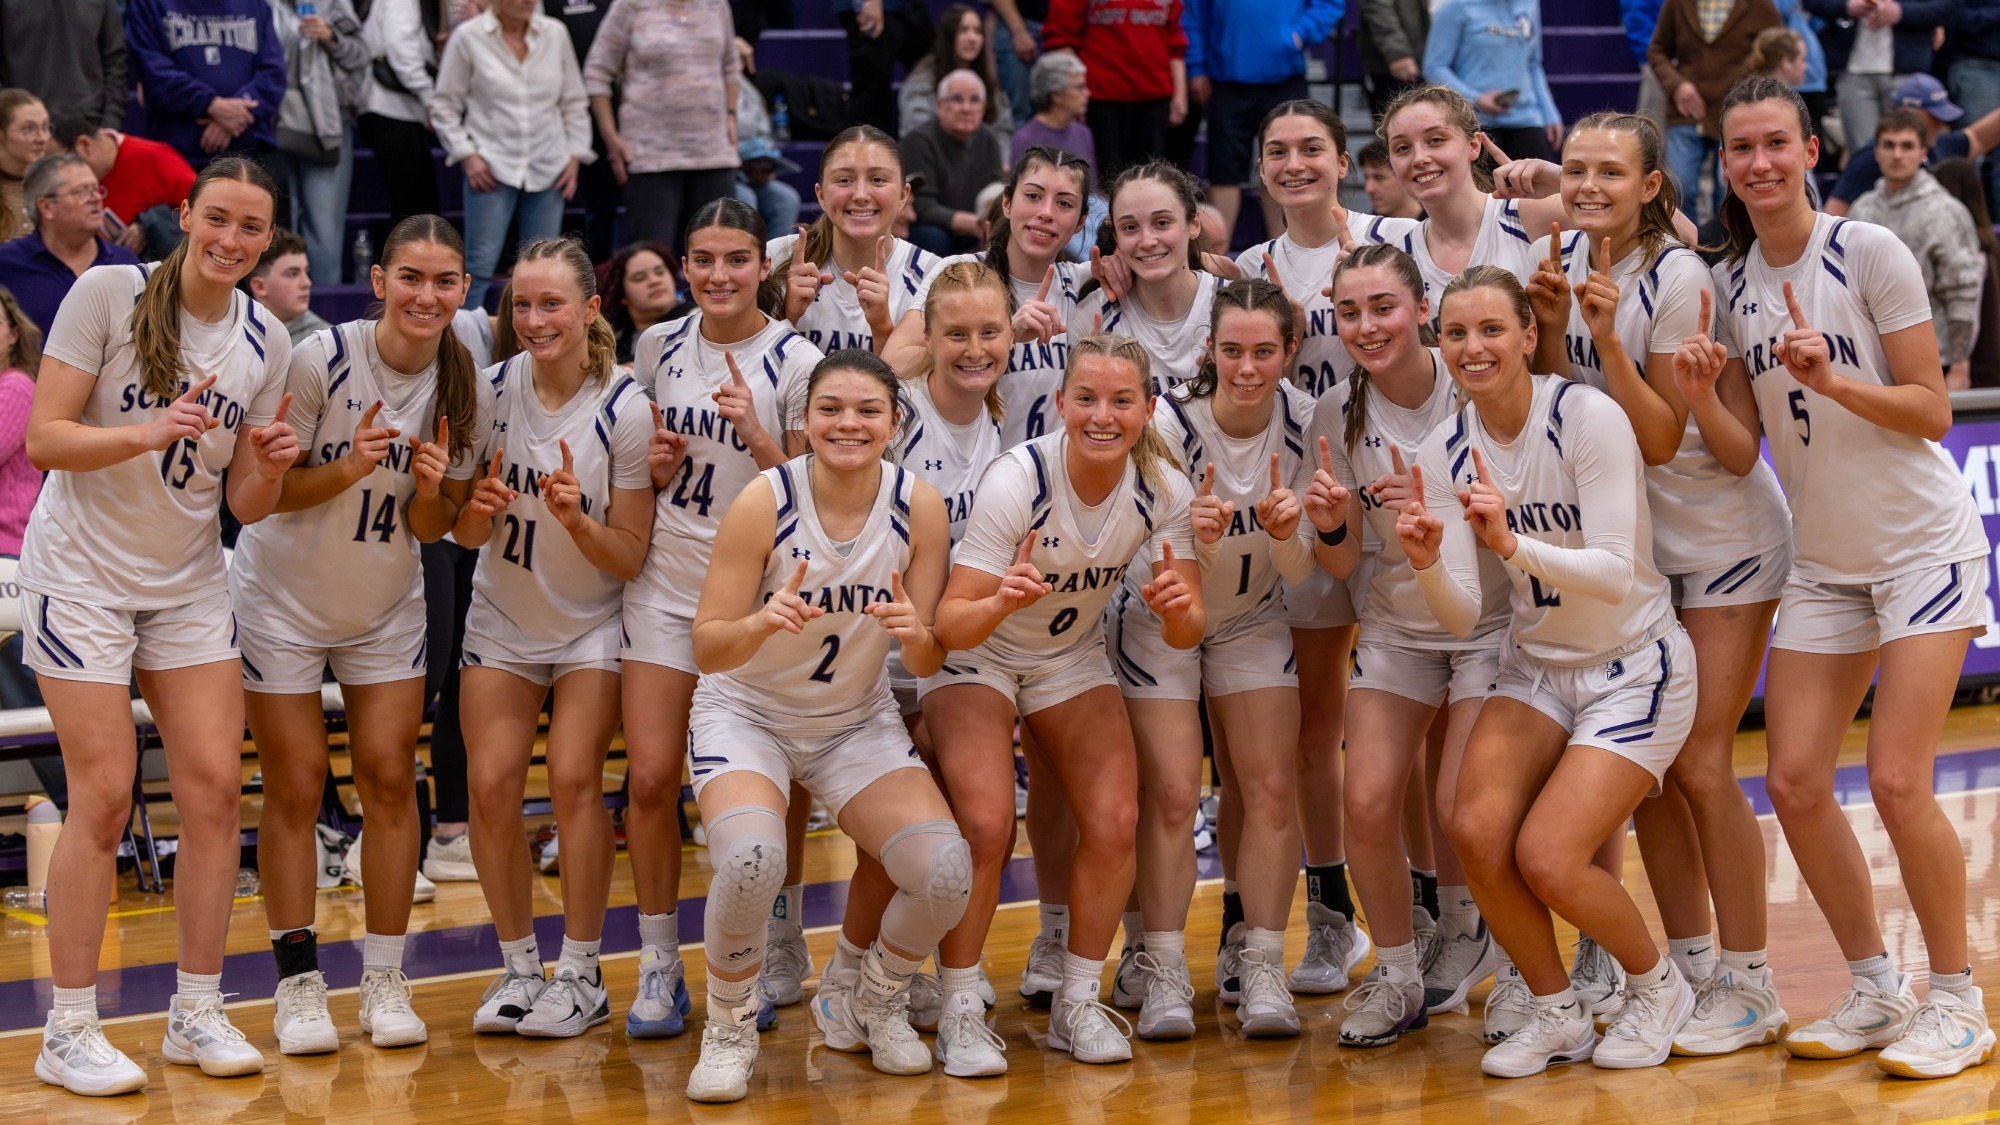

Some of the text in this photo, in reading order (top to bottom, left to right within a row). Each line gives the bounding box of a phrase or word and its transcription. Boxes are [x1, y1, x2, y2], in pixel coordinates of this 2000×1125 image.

[1303, 308, 1339, 339] NT
[1004, 342, 1071, 375] RANT
[1299, 361, 1337, 398] 30
[1745, 332, 1861, 381] CRAON
[660, 406, 754, 458] RANTO
[1026, 394, 1048, 440] 6
[1788, 389, 1811, 447] 5
[161, 437, 198, 490] 15
[319, 440, 414, 475] SCNT
[670, 455, 716, 518] 24
[352, 488, 397, 543] 14
[502, 514, 537, 573] 21
[1234, 552, 1252, 597] 1
[1047, 607, 1079, 637] 0
[808, 633, 841, 685] 2
